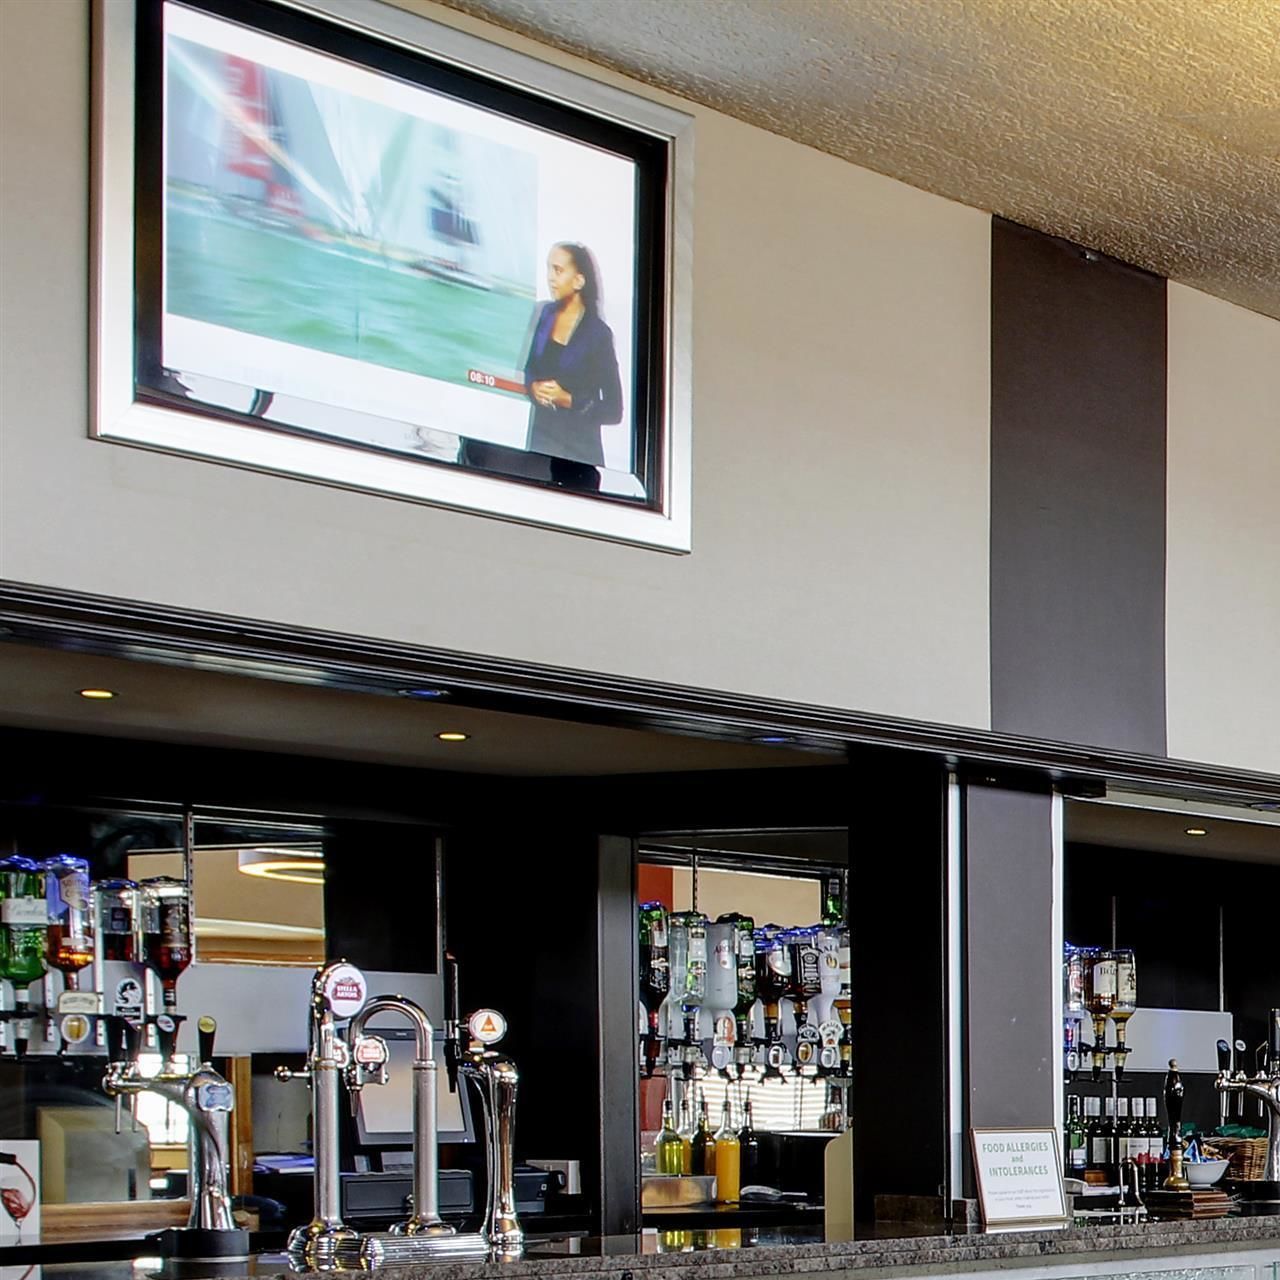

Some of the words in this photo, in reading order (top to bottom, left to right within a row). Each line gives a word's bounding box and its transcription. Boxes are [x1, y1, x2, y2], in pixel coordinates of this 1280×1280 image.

[470, 371, 495, 386] 08:10
[982, 1143, 1005, 1153] FOOD
[1006, 1142, 1049, 1153] ALLERGIES
[1011, 1154, 1024, 1163] and
[989, 1165, 1049, 1176] INTOLERANCES
